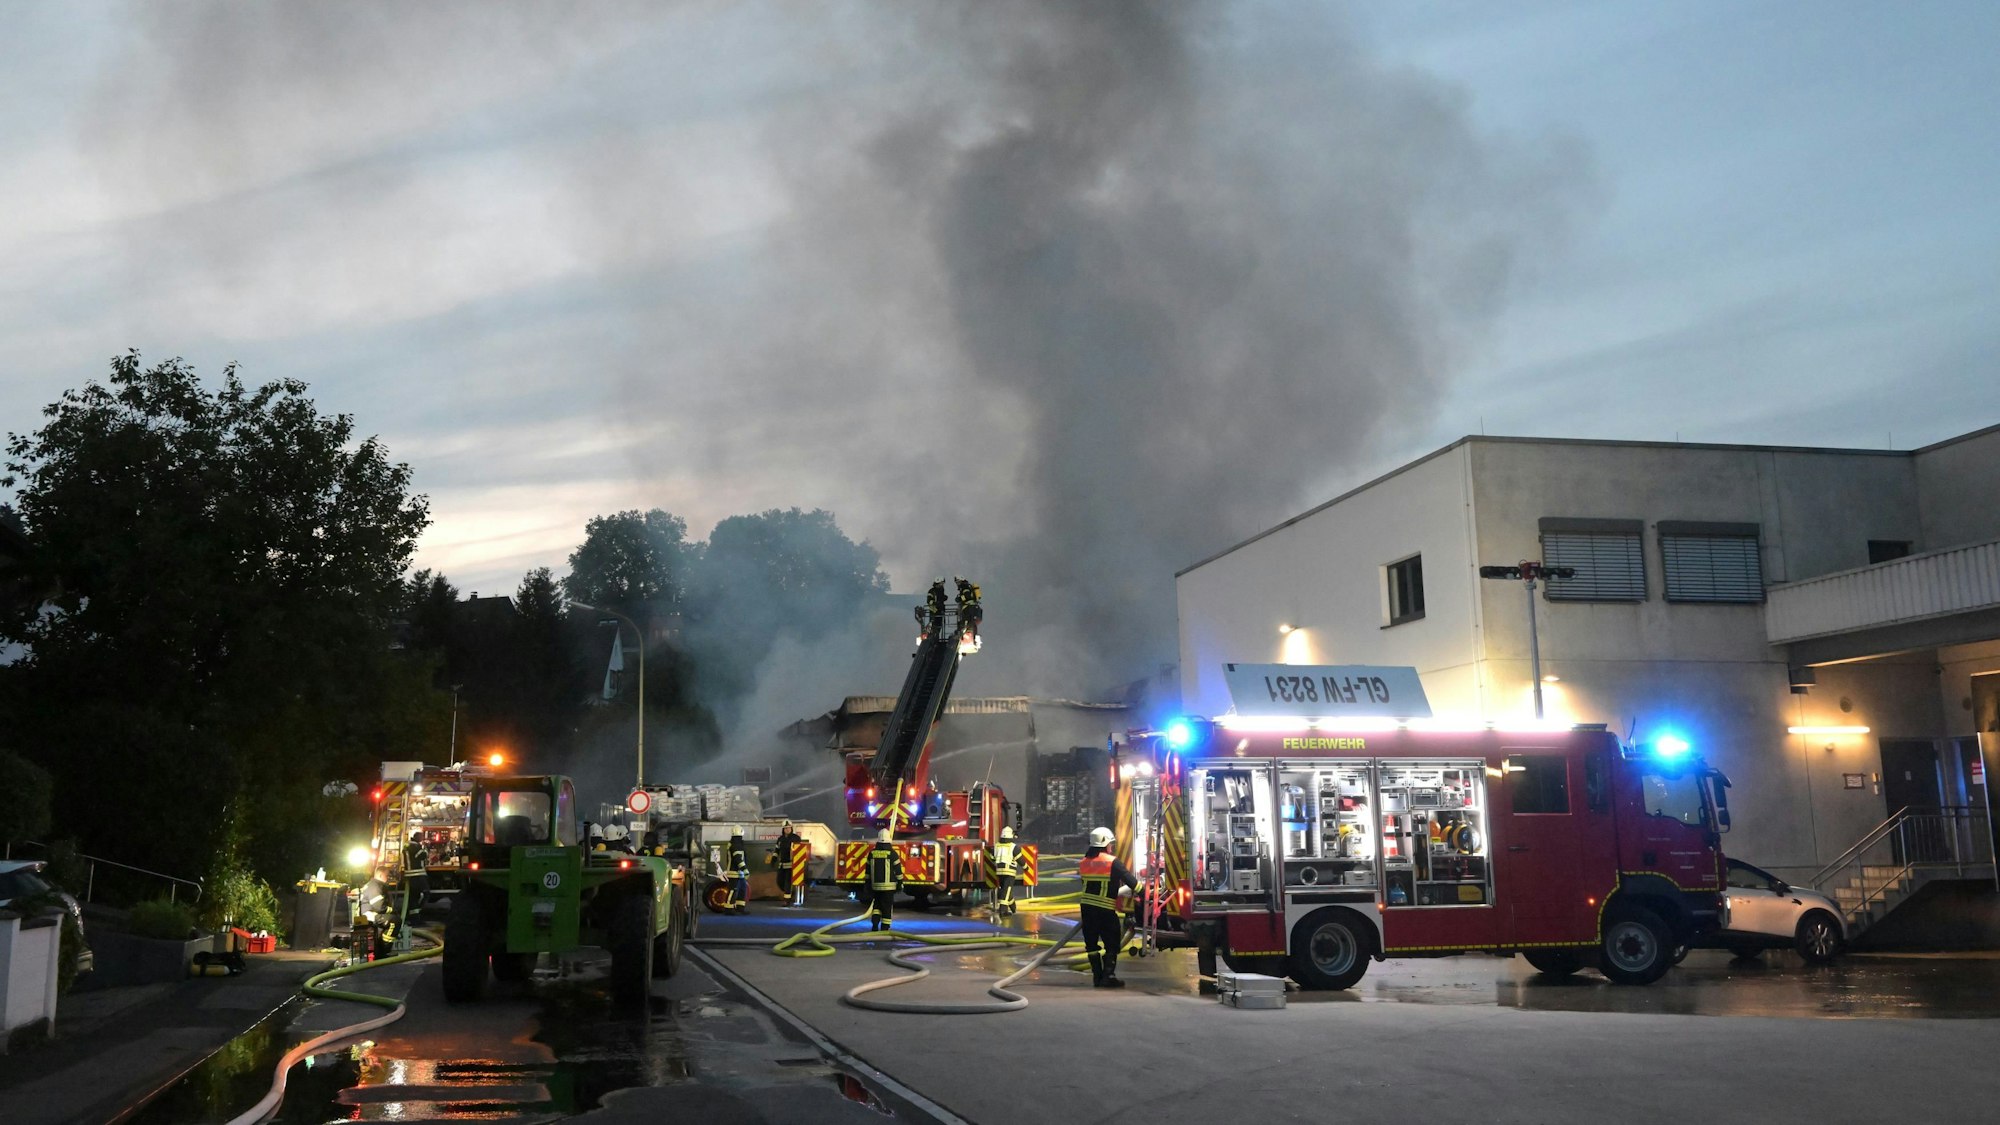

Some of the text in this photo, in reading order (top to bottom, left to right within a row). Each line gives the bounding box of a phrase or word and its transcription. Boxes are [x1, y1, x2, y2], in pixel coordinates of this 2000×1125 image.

[1264, 676, 1390, 703] GL-FW 8231
[1283, 737, 1365, 750] FEUERWEHR
[546, 874, 558, 886] 20
